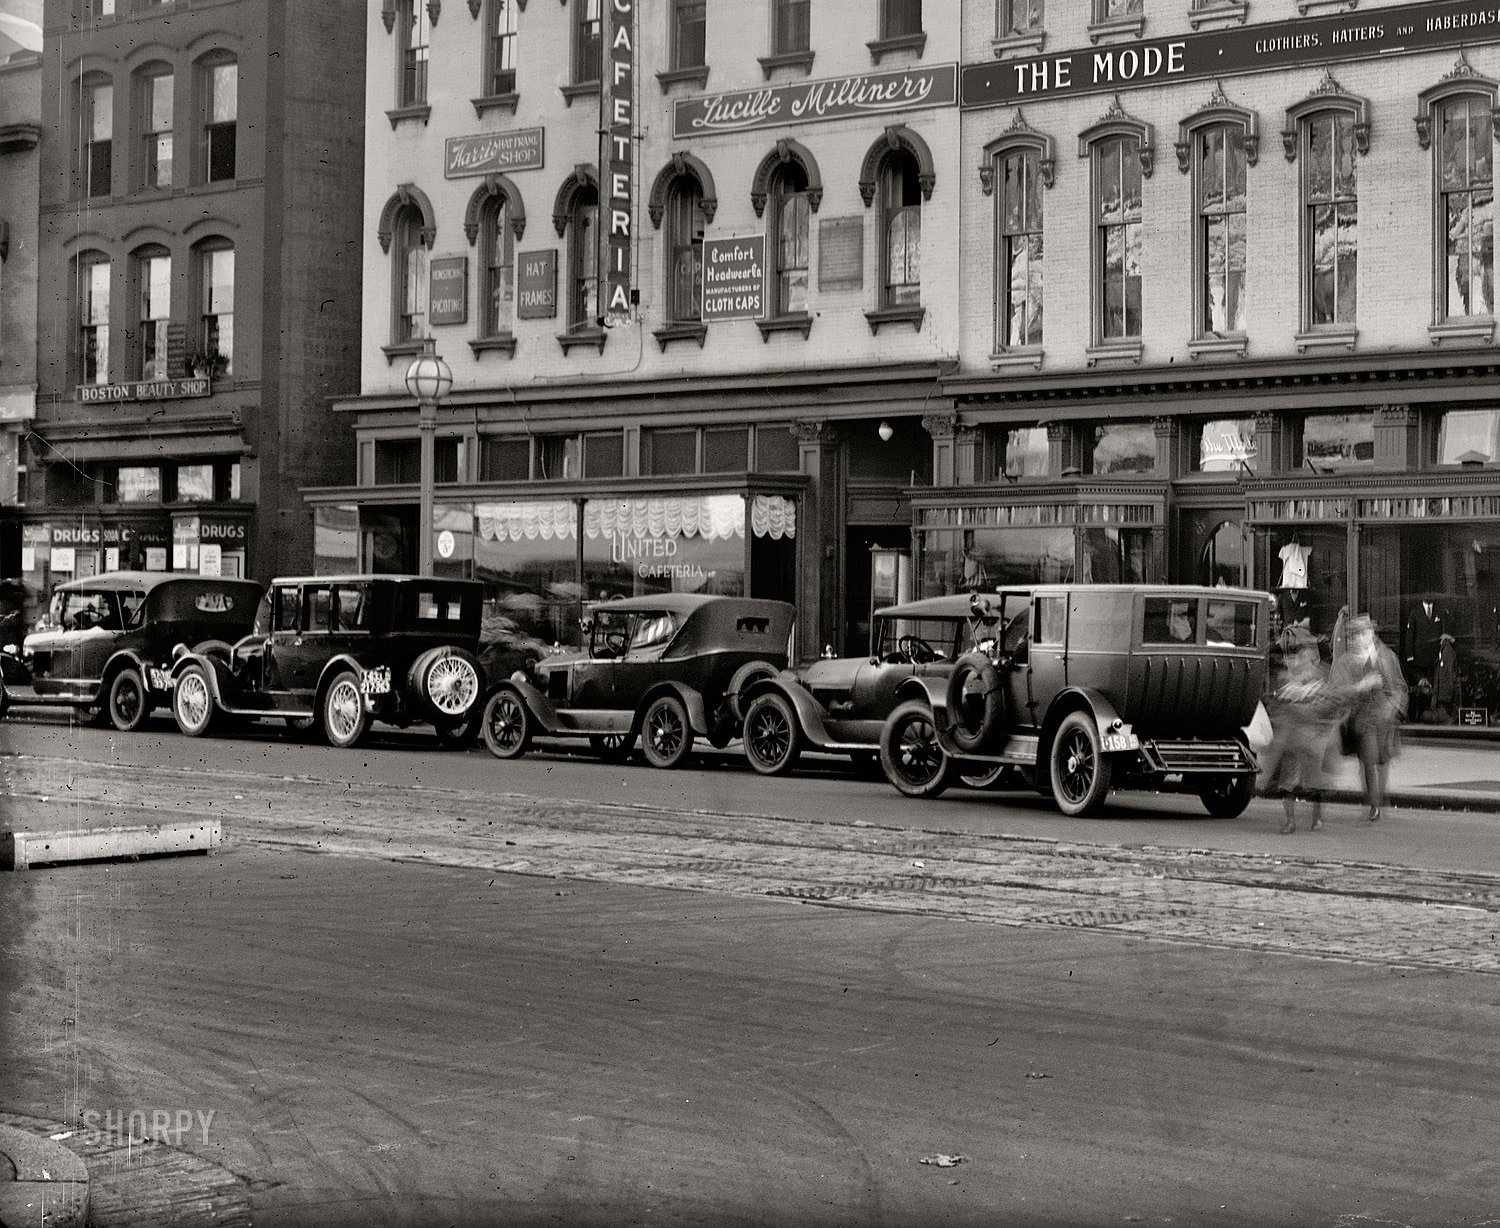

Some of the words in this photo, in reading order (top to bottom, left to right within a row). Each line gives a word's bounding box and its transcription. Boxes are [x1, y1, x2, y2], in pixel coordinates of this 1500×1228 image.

[1014, 59, 1072, 95] THE
[1092, 42, 1187, 85] MODE
[1255, 33, 1323, 53] CLOTHIERS,
[1332, 25, 1385, 44] HATTERS
[1396, 25, 1415, 37] AND
[692, 90, 781, 128] Lucille
[791, 76, 935, 118] Millinery
[450, 140, 498, 170] Harris
[498, 148, 537, 164] SHOP
[711, 245, 754, 263] Comfort
[526, 262, 547, 277] HAT
[707, 267, 751, 282] Headwear
[520, 289, 552, 307] FRAMES
[705, 285, 752, 295] MANUFACTURERS
[752, 284, 760, 292] OF
[432, 298, 462, 313] PICOTING
[705, 297, 733, 313] CLOTH
[735, 295, 760, 311] CAPS
[82, 385, 129, 401] BOSTON
[136, 382, 176, 398] BEAUTY
[180, 380, 206, 395] SHOP
[53, 528, 100, 543] DRUGS
[201, 524, 246, 539] DRUGS
[612, 532, 677, 562] UNITED
[638, 564, 704, 578] CAFETERIA
